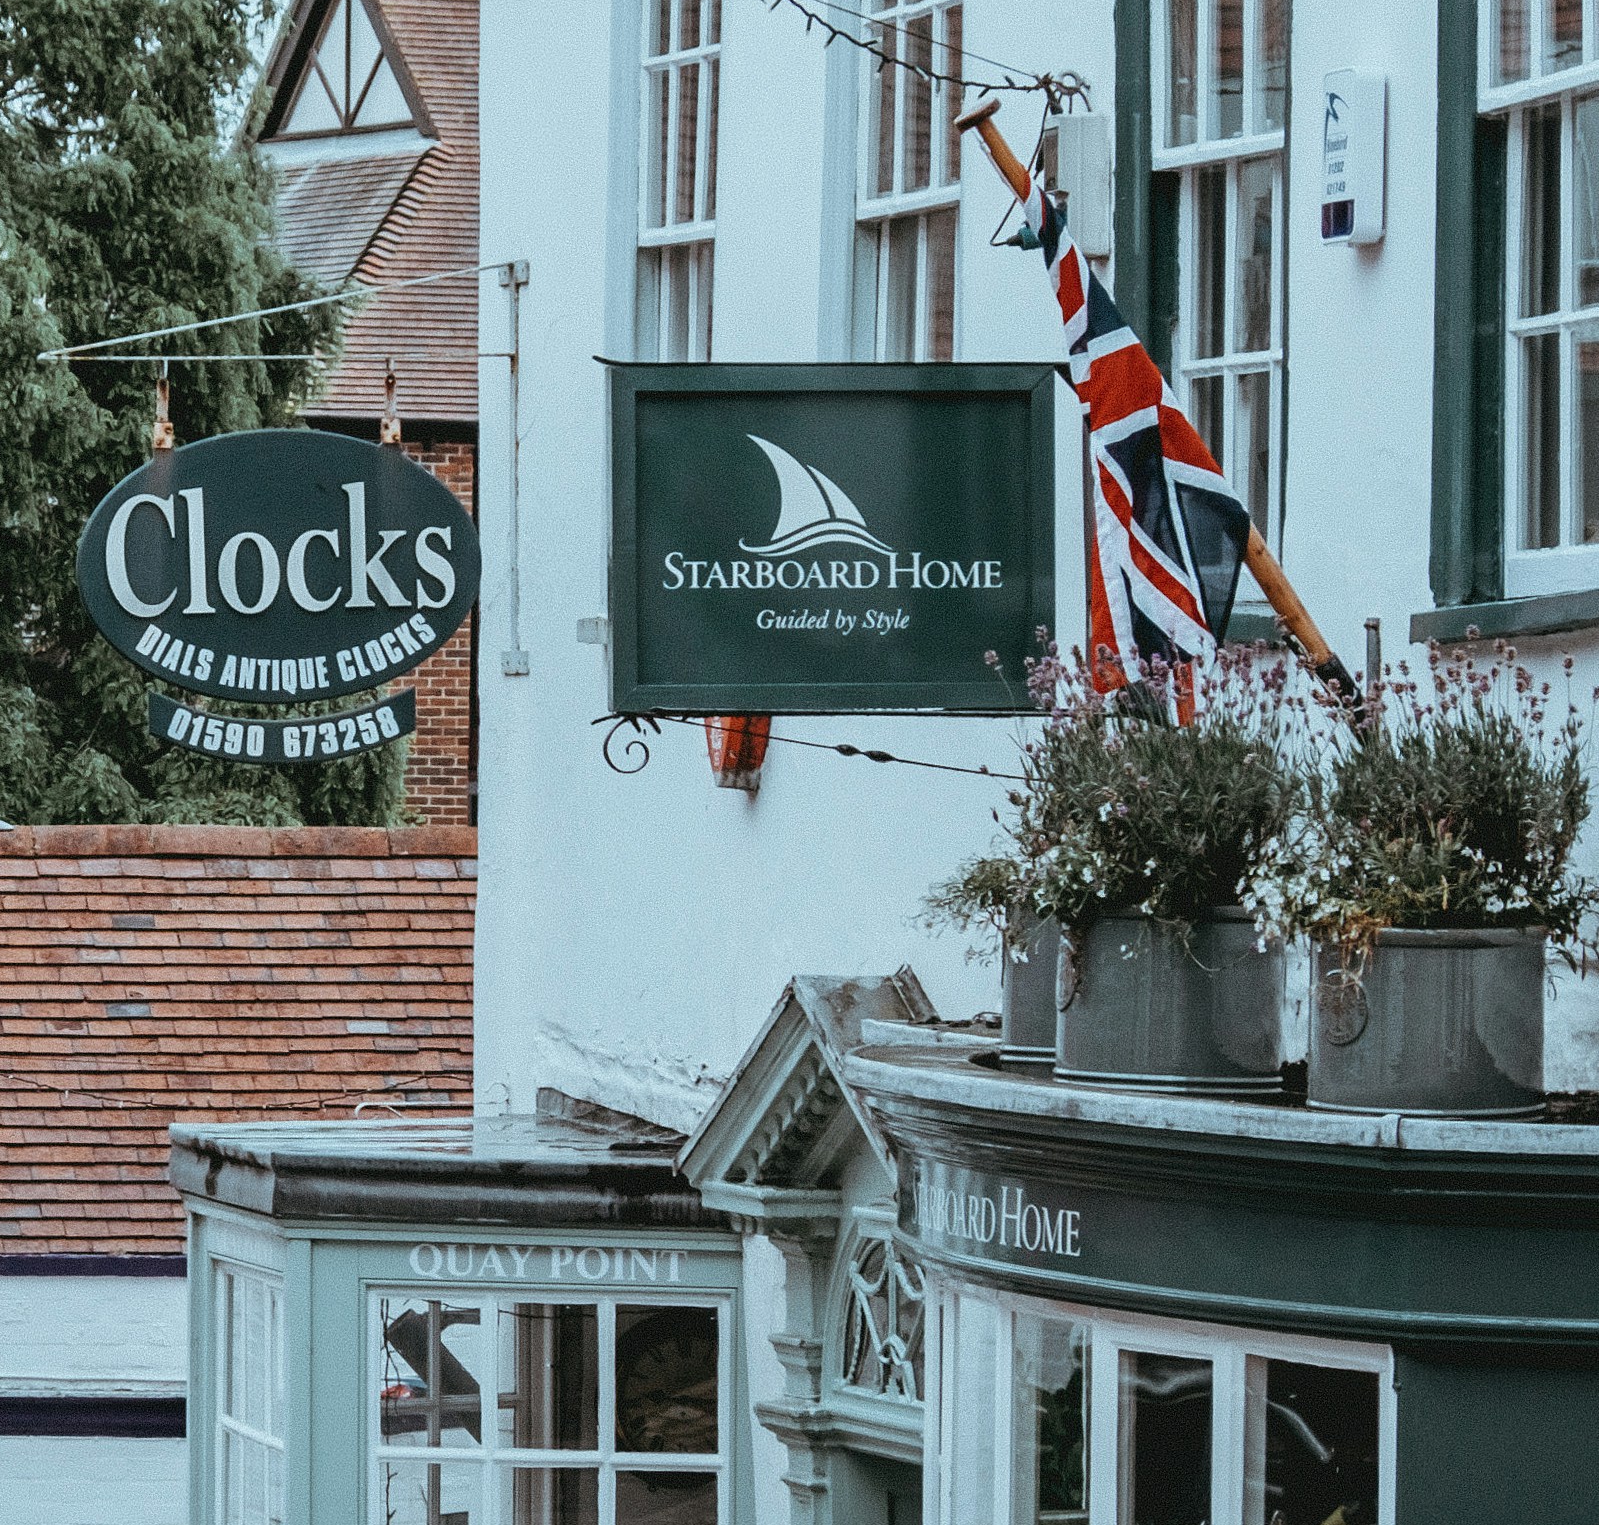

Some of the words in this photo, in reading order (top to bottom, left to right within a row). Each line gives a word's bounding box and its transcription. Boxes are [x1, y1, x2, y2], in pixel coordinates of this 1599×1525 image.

[105, 481, 456, 618] Clocks
[662, 551, 879, 590] STARBOARD
[886, 552, 1003, 590] HOME
[756, 608, 830, 630] Guided
[834, 608, 857, 636] by
[861, 608, 910, 636] Style
[135, 623, 214, 681] DIALS
[219, 654, 329, 695] ANTIQUE
[336, 612, 436, 682] CLOCKS
[167, 707, 265, 757] 01590
[283, 706, 400, 758] 673258
[1000, 1186, 1081, 1257] HOME
[409, 1244, 535, 1279] QUAY
[549, 1246, 688, 1282] POINT
